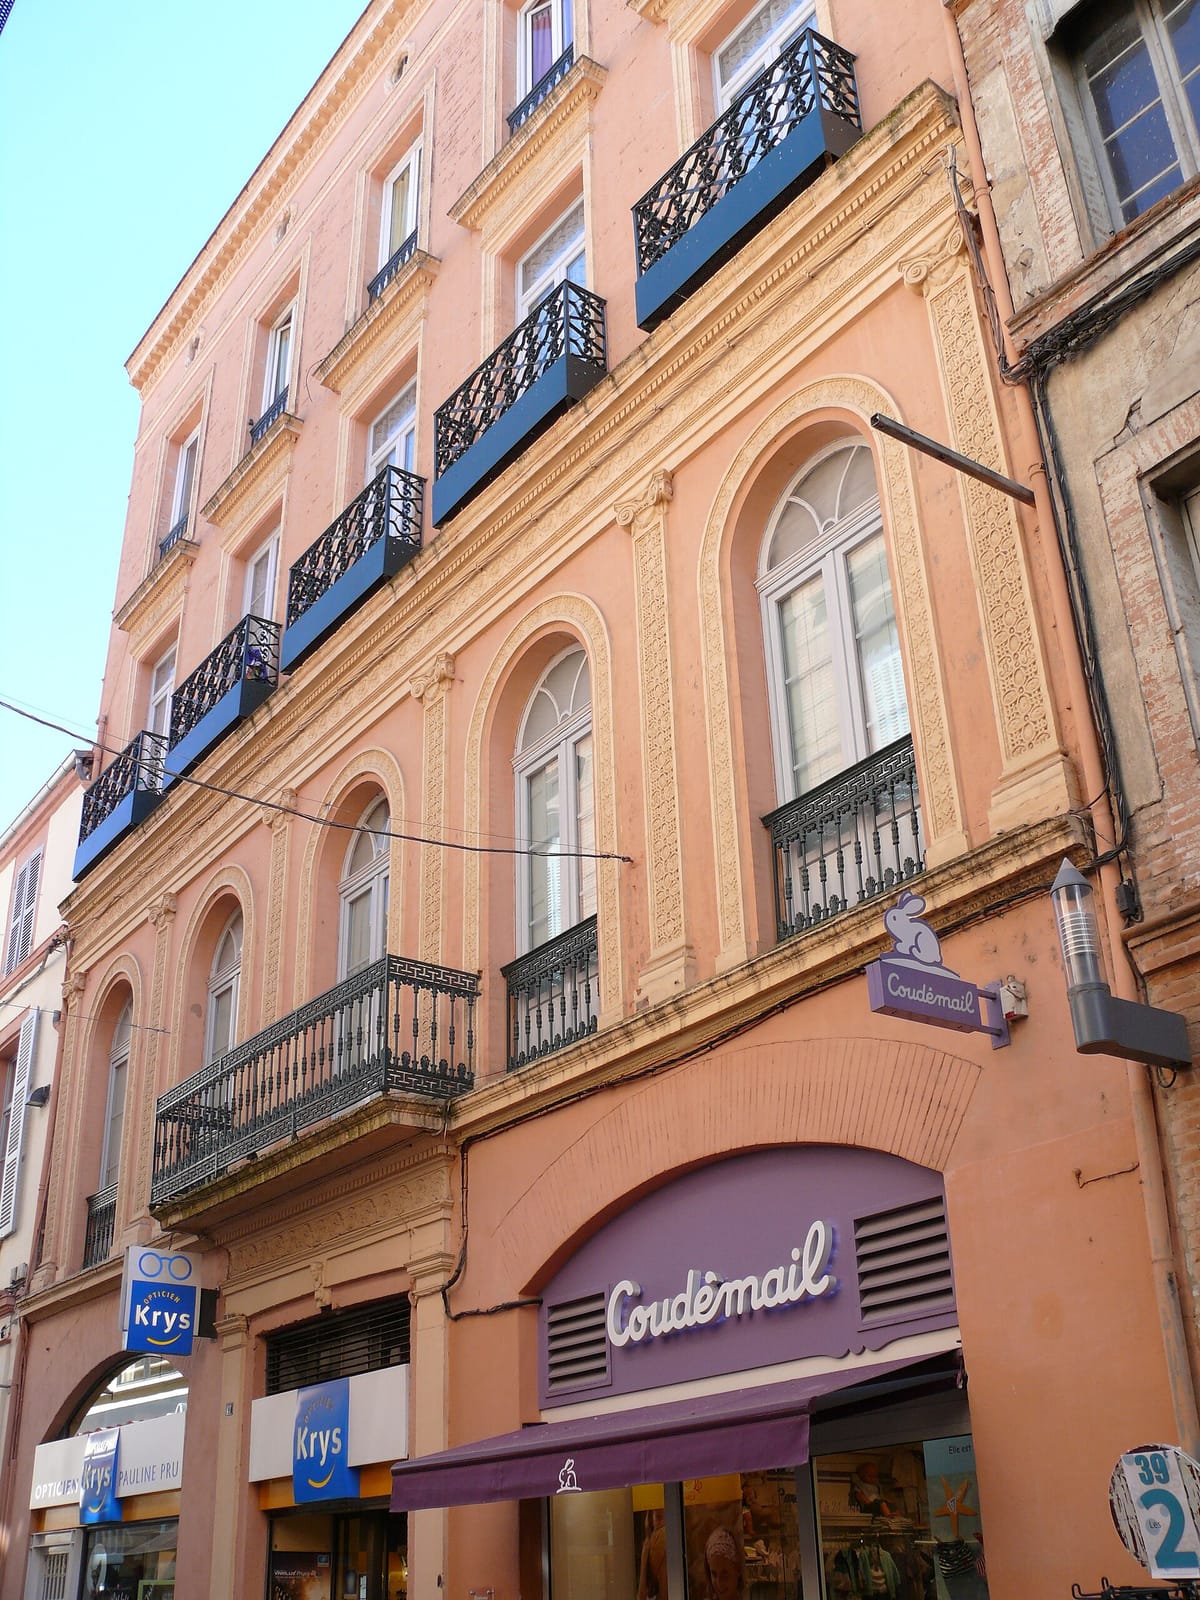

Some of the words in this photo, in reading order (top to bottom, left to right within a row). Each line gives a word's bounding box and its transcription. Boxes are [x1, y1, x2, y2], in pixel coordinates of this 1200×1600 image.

[143, 1290, 181, 1305] OPTICIEN
[134, 1304, 191, 1334] Krys
[296, 1426, 342, 1467] Krys
[81, 1463, 112, 1496] Krys
[118, 1465, 156, 1487] PAULINE
[1140, 1488, 1199, 1569] 2
